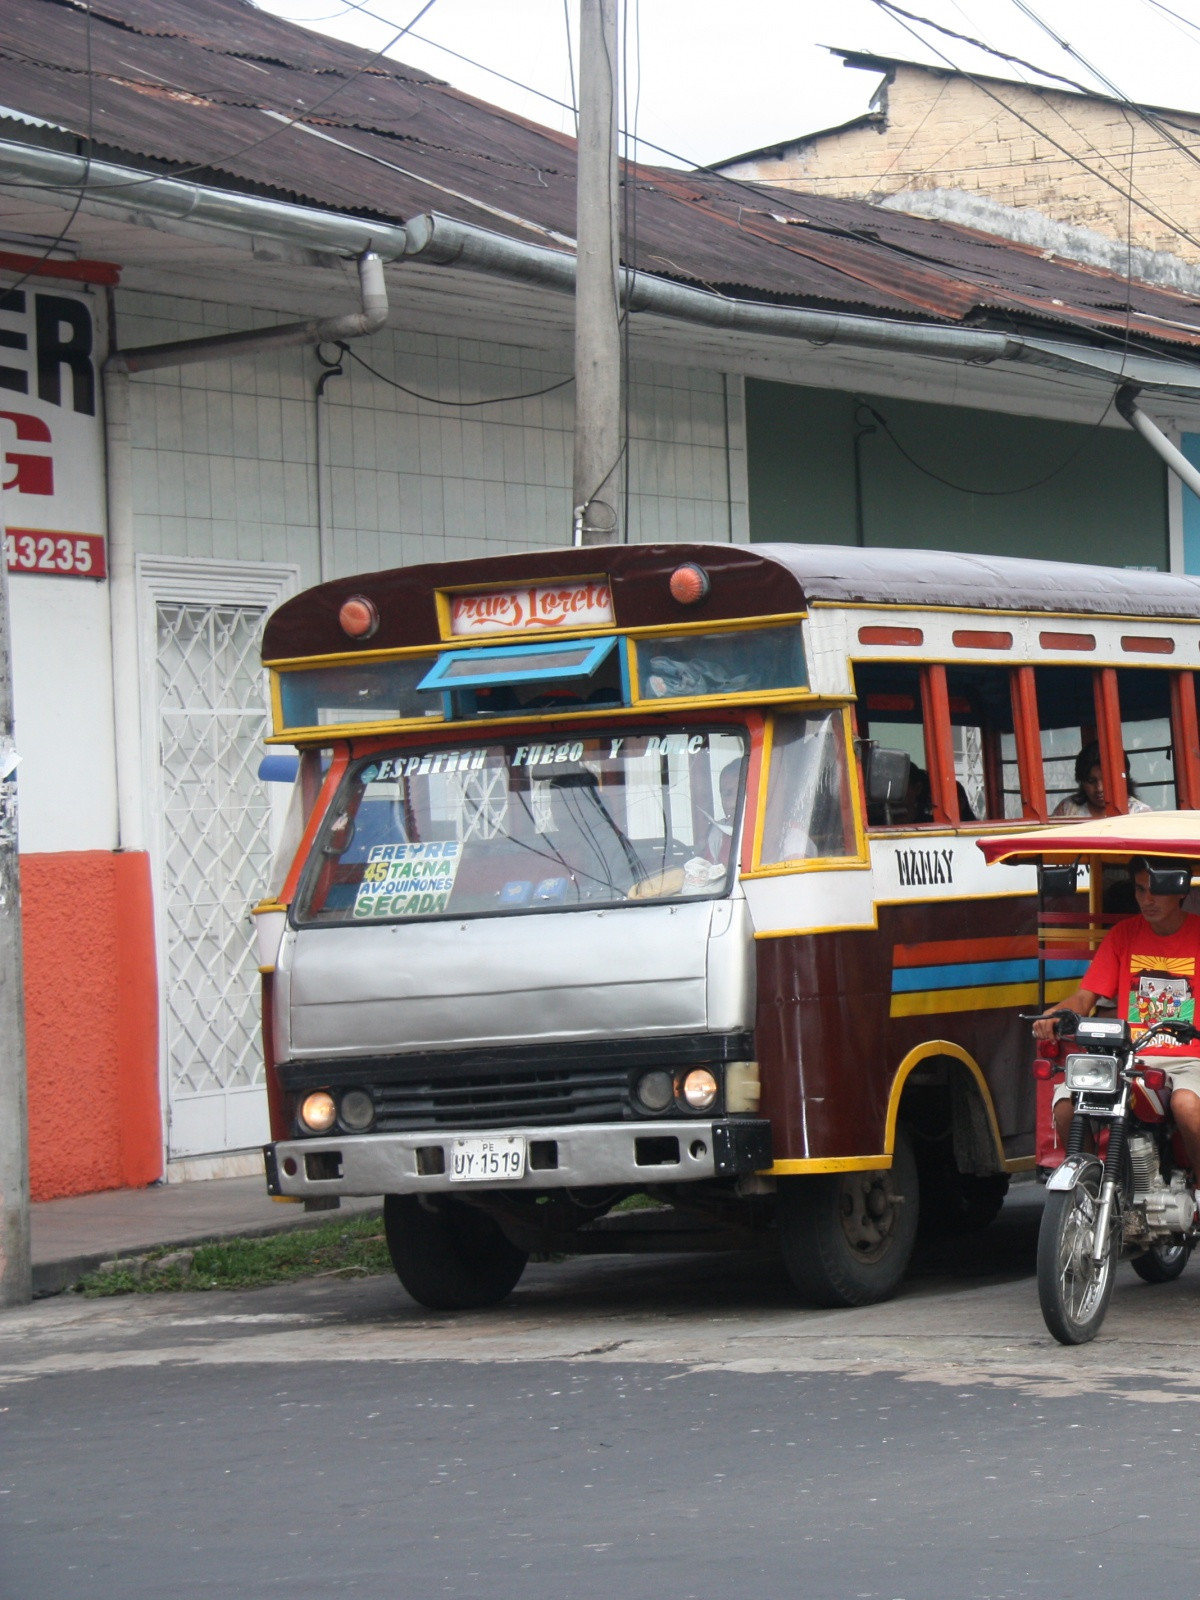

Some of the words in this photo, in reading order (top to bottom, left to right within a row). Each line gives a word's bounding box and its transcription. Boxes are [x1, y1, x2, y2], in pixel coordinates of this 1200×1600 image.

[370, 841, 459, 861] FREYRE
[364, 862, 389, 882] 45
[390, 860, 451, 879] TACNA
[354, 892, 448, 917] SECADA
[482, 1143, 495, 1152] PE
